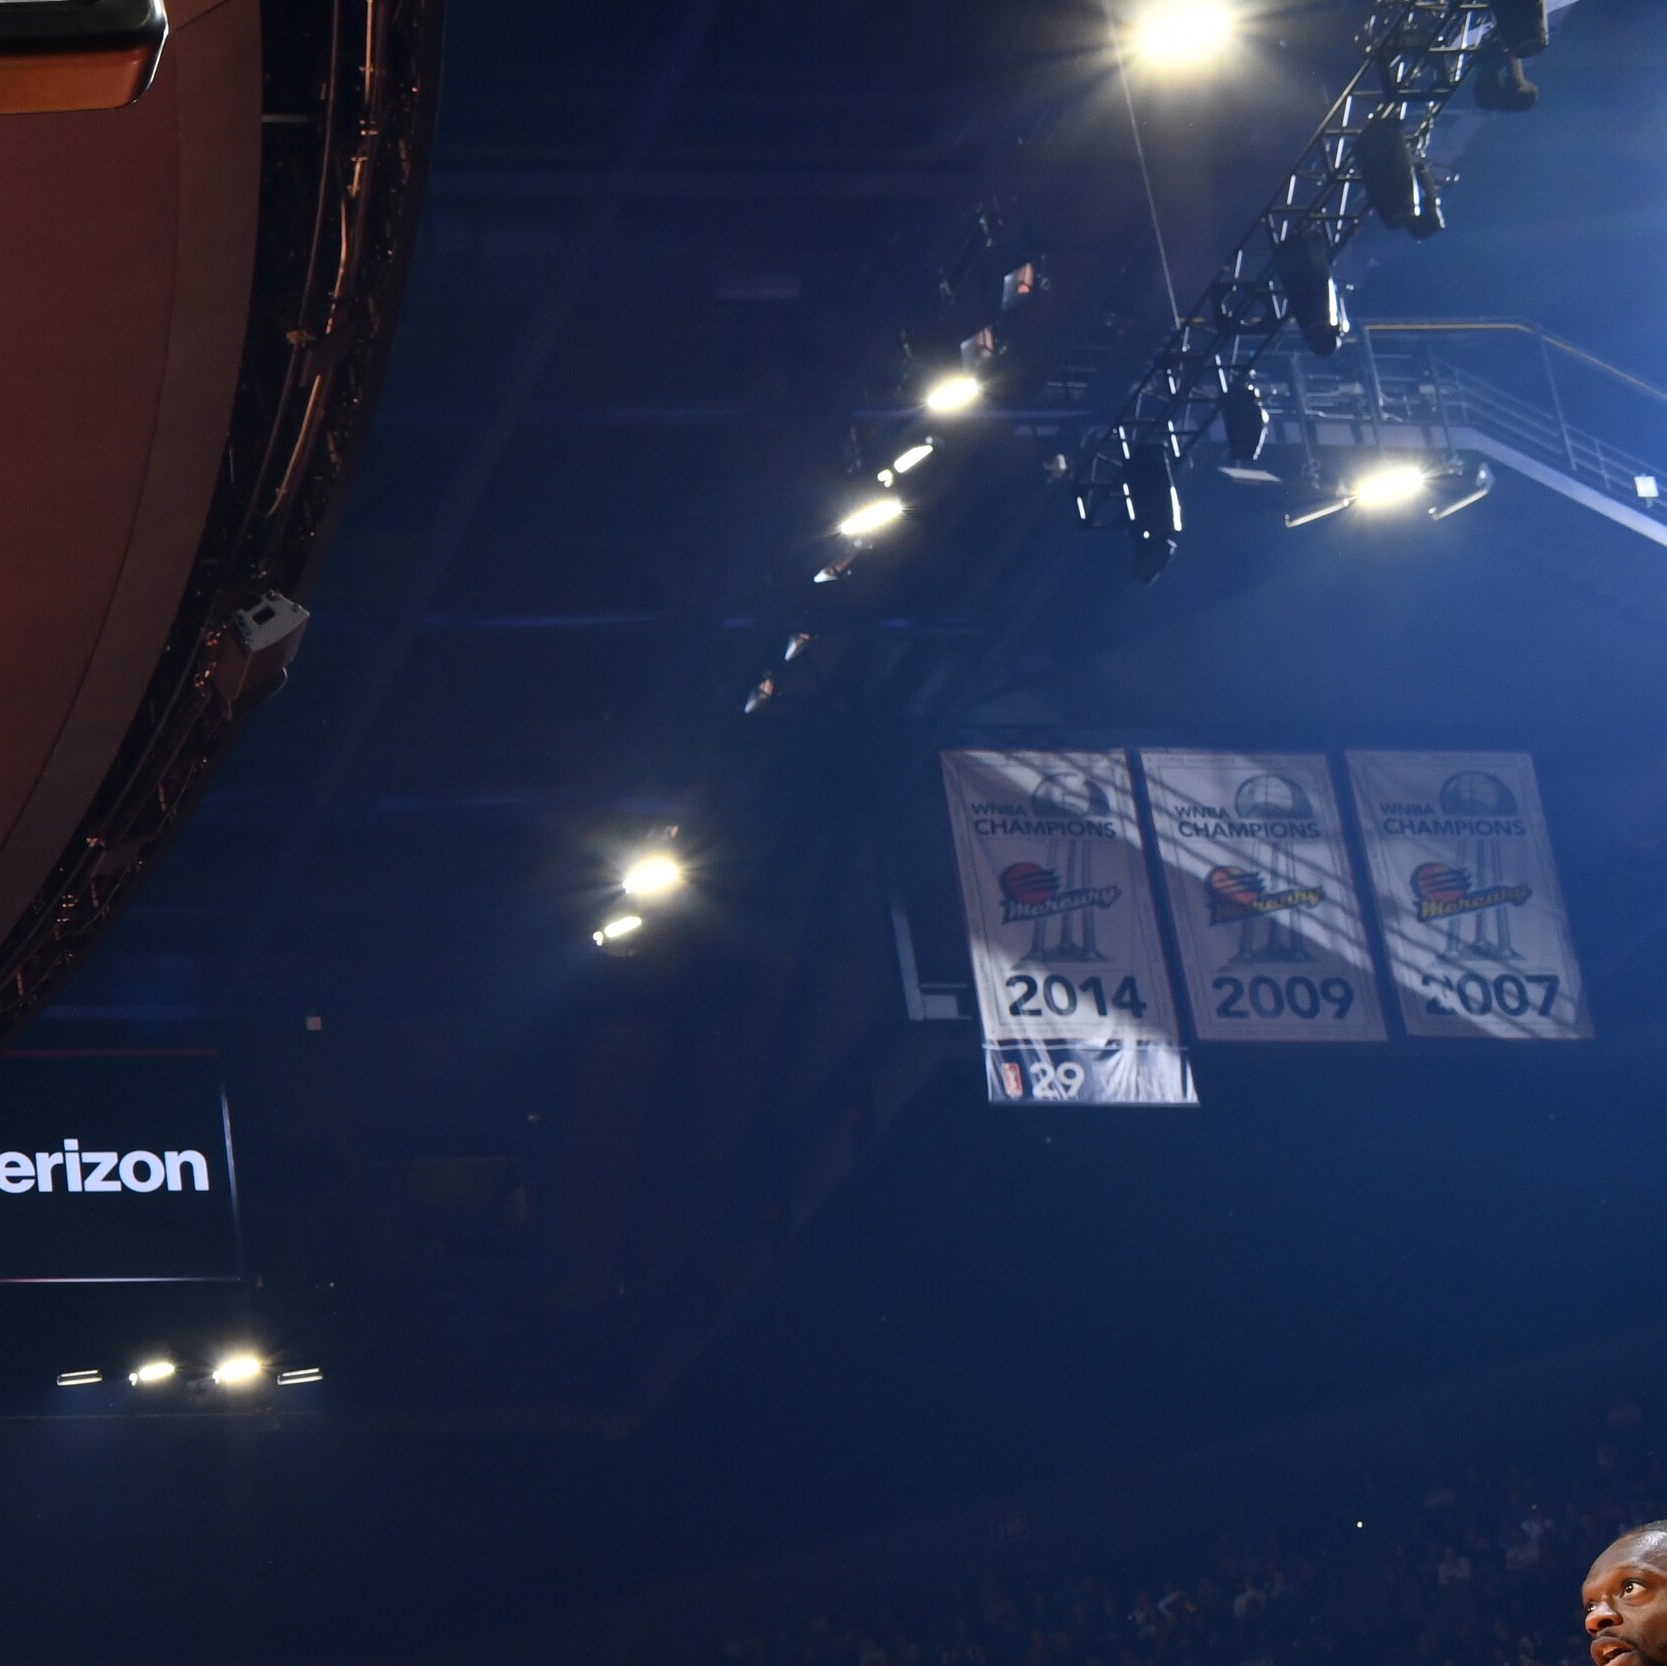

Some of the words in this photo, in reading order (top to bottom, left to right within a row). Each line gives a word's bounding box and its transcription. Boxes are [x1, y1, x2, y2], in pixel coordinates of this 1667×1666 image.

[970, 803, 1027, 817] WNBA
[1175, 805, 1230, 820] WNBA
[1380, 802, 1435, 816] WNBA
[974, 819, 1116, 839] CHAMPIONS
[1178, 821, 1321, 840] CHAMPIONS
[1383, 819, 1527, 837] CHAMPIONS
[1006, 974, 1147, 1019] 2014
[1212, 976, 1355, 1019] 2009
[1421, 973, 1560, 1018] 2007
[1030, 1062, 1084, 1100] 29
